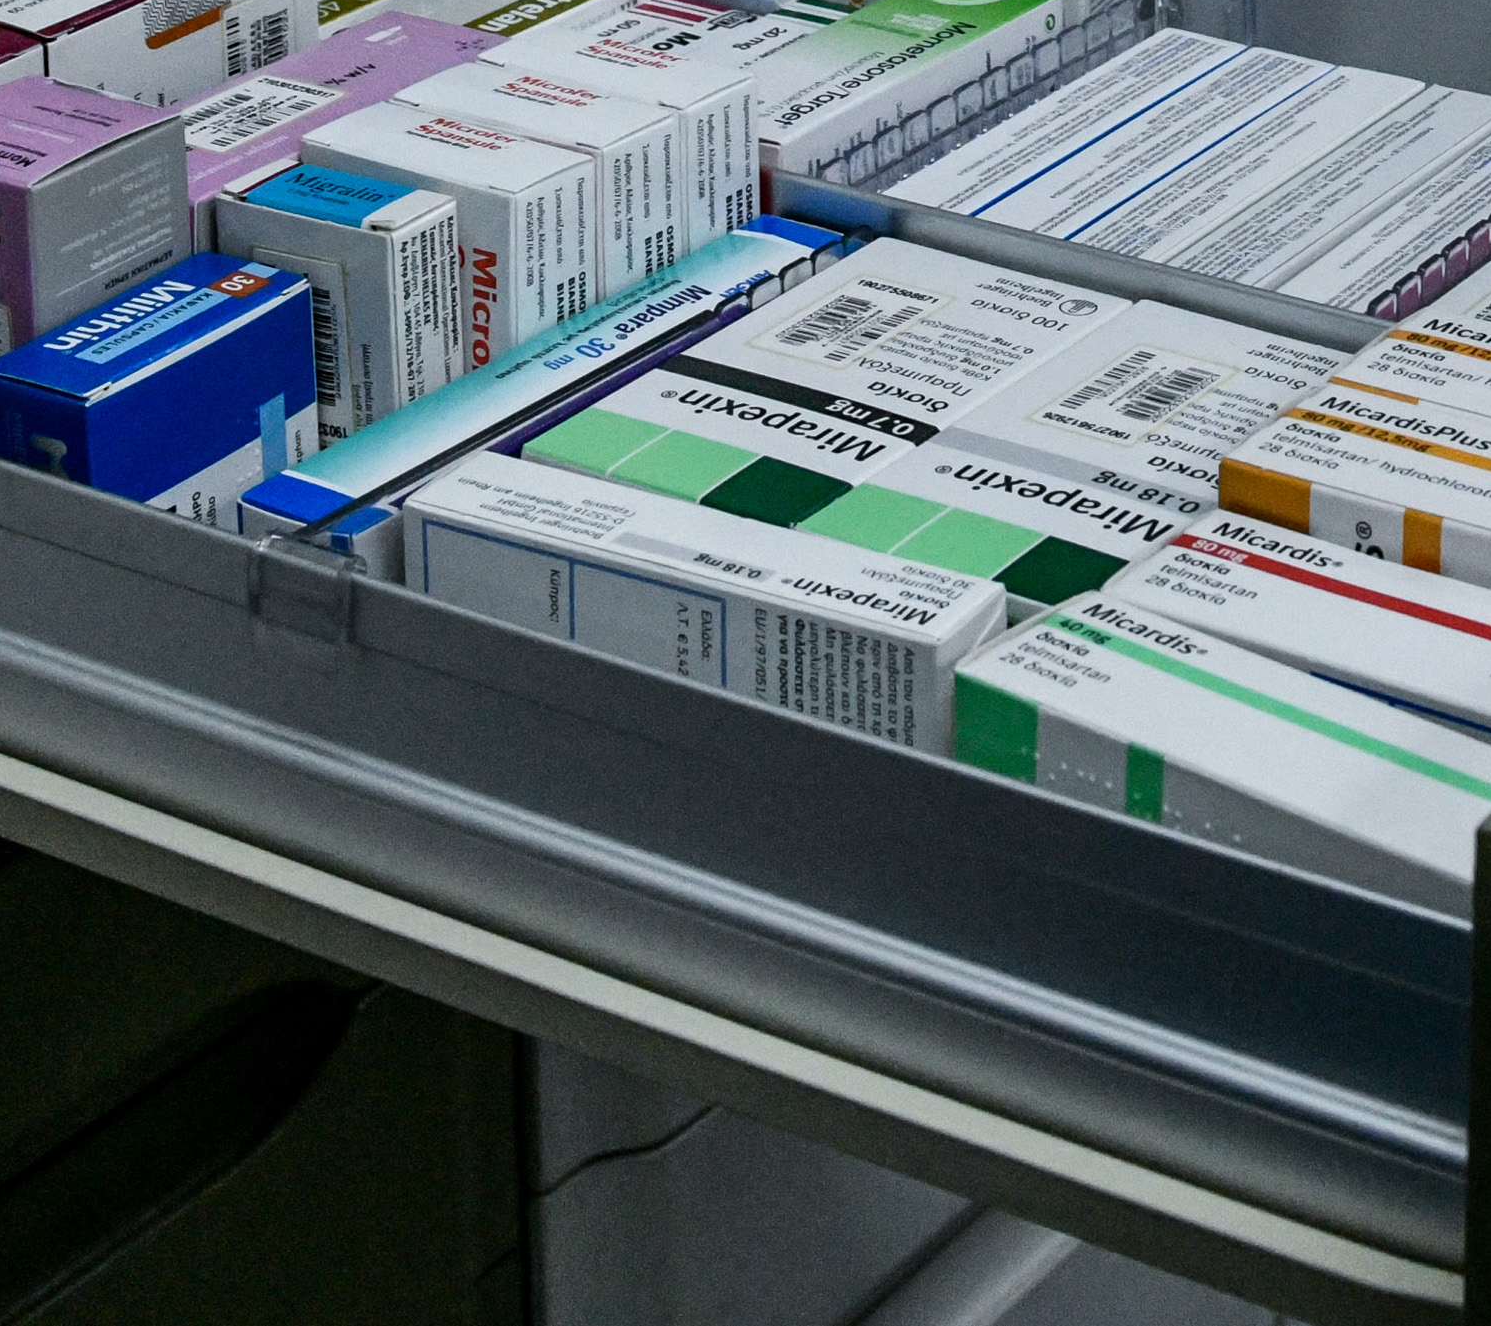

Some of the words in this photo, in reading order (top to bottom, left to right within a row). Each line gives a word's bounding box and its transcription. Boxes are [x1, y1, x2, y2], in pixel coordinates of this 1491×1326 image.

[733, 36, 761, 52] mg
[763, 27, 788, 39] 20
[587, 45, 670, 69] Spansule
[598, 38, 680, 63] Microfer
[774, 21, 977, 126] Mometasone/Target
[505, 82, 589, 107] Spansule
[515, 76, 600, 100] Microfer
[415, 123, 503, 151] Spansule
[429, 117, 514, 145] Microfer
[285, 172, 387, 204] Migralin
[420, 231, 429, 278] MENARINI
[220, 274, 256, 291] 30
[422, 279, 430, 312] HELLAS
[578, 272, 587, 311] OSMO
[975, 283, 1053, 308] Boehringer
[995, 277, 1065, 301] Ingelheim
[473, 248, 497, 371] Micro
[556, 283, 565, 323] BIANE
[568, 277, 576, 317] BIANE
[969, 299, 1030, 320] δισκία
[43, 281, 197, 351] Milithin
[615, 285, 712, 339] Mimpara
[1032, 315, 1070, 332] 100
[575, 338, 616, 359] 30
[991, 336, 1012, 348] mg
[1016, 345, 1034, 355] 0.7
[1266, 343, 1339, 369] Ingelheim
[1391, 344, 1448, 365] δισκία
[543, 353, 574, 371] mg
[857, 356, 972, 396] Πραμιπεξόλ
[959, 357, 979, 368] mg
[982, 364, 1001, 374] 1.0
[1246, 348, 1329, 377] Boehringer
[1365, 360, 1392, 376] 28
[1393, 368, 1448, 390] δισκία
[1379, 350, 1482, 390] telmisartan/
[1244, 366, 1307, 390] δισκία
[825, 398, 872, 424] mg
[867, 381, 949, 413] δισκία
[678, 388, 886, 465] Mirapexin
[875, 413, 917, 437] 0.7
[1284, 422, 1343, 445] δισκία
[1257, 439, 1283, 455] 28
[1285, 447, 1340, 472] δισκία
[1270, 430, 1376, 473] telmisartan/
[1097, 469, 1133, 491] mg
[479, 503, 538, 523] Ingelheim
[497, 498, 537, 513] GmbH
[952, 463, 1175, 543] Mirapexin
[1136, 484, 1202, 515] 0.18
[538, 508, 615, 532] International
[539, 519, 604, 540] Boehringer
[693, 552, 720, 567] mg
[1190, 535, 1212, 553] 80
[1211, 543, 1249, 564] mg
[1211, 521, 1333, 570] Micardis
[721, 560, 762, 580] 0.18
[1173, 553, 1232, 577] δισκία
[546, 569, 563, 623] Κύπρος:
[947, 577, 976, 592] 30
[1144, 573, 1168, 590] 28
[1169, 581, 1228, 607] δισκία
[1159, 562, 1260, 602] telmisartan
[793, 574, 938, 627] Mirapexin
[900, 589, 952, 609] δισκία
[700, 610, 713, 663] Ελλάδα:
[1058, 617, 1084, 634] 40
[1081, 627, 1112, 646] mg
[1082, 601, 1196, 655] Micardis
[1034, 630, 1091, 659] δισκία
[998, 651, 1022, 668] 28
[1023, 661, 1078, 689] δισκία
[1016, 641, 1112, 684] telmisartan
